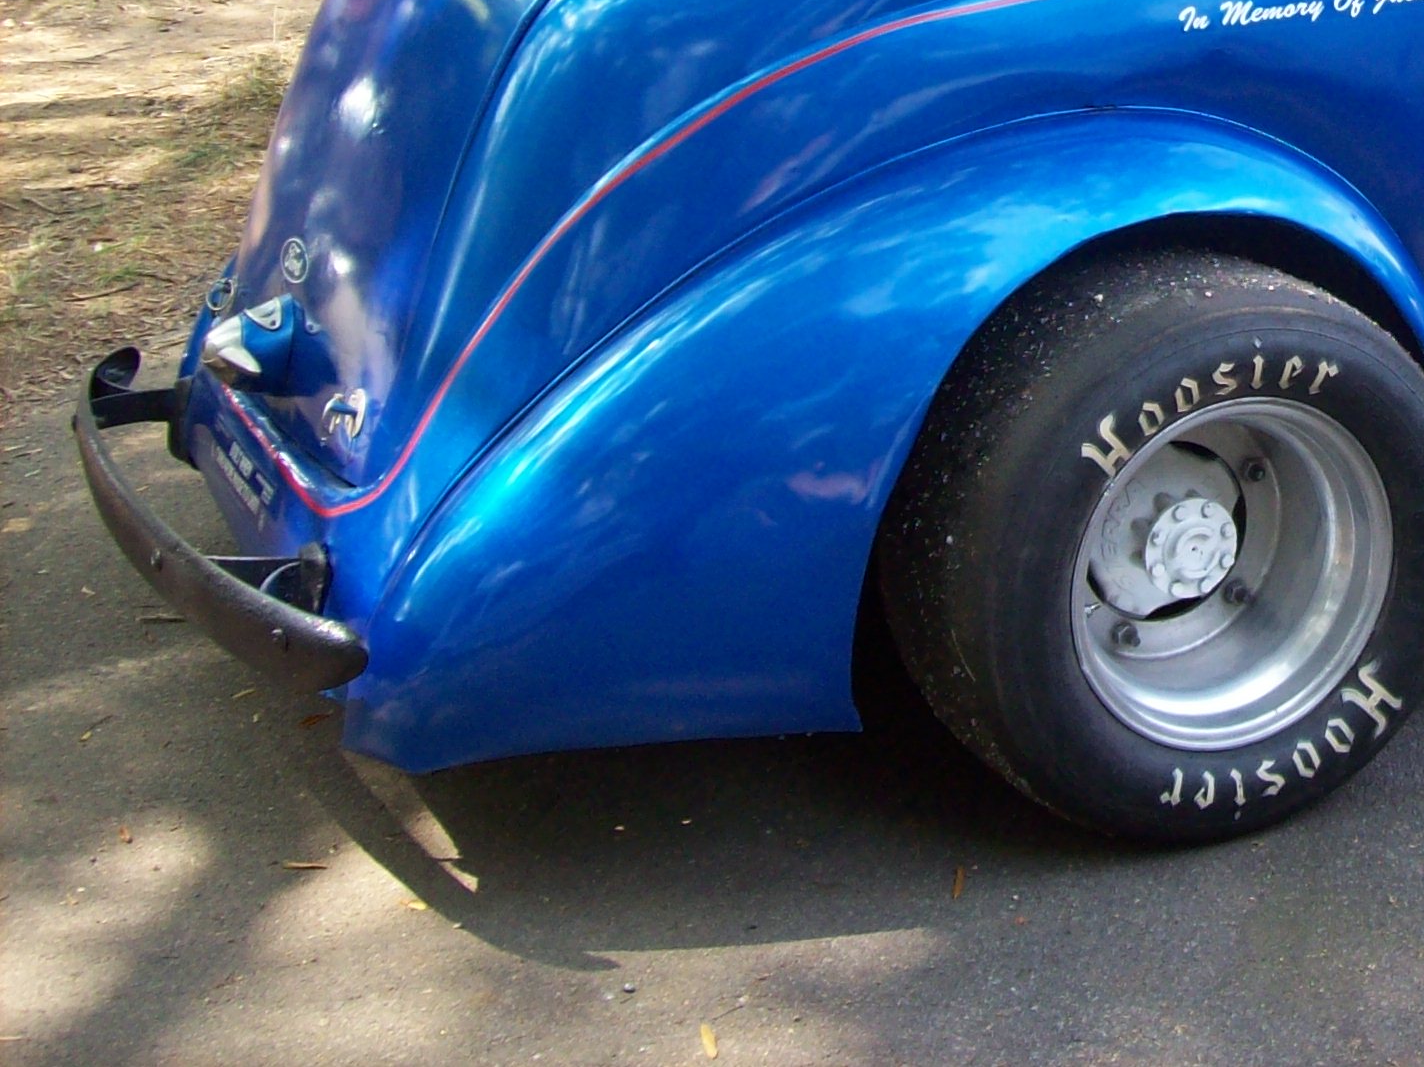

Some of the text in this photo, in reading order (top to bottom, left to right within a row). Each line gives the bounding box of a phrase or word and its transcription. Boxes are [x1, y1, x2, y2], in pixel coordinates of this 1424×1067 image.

[1178, 6, 1210, 32] In
[1081, 337, 1340, 476] Hoosier
[1160, 658, 1402, 820] Hoosier
